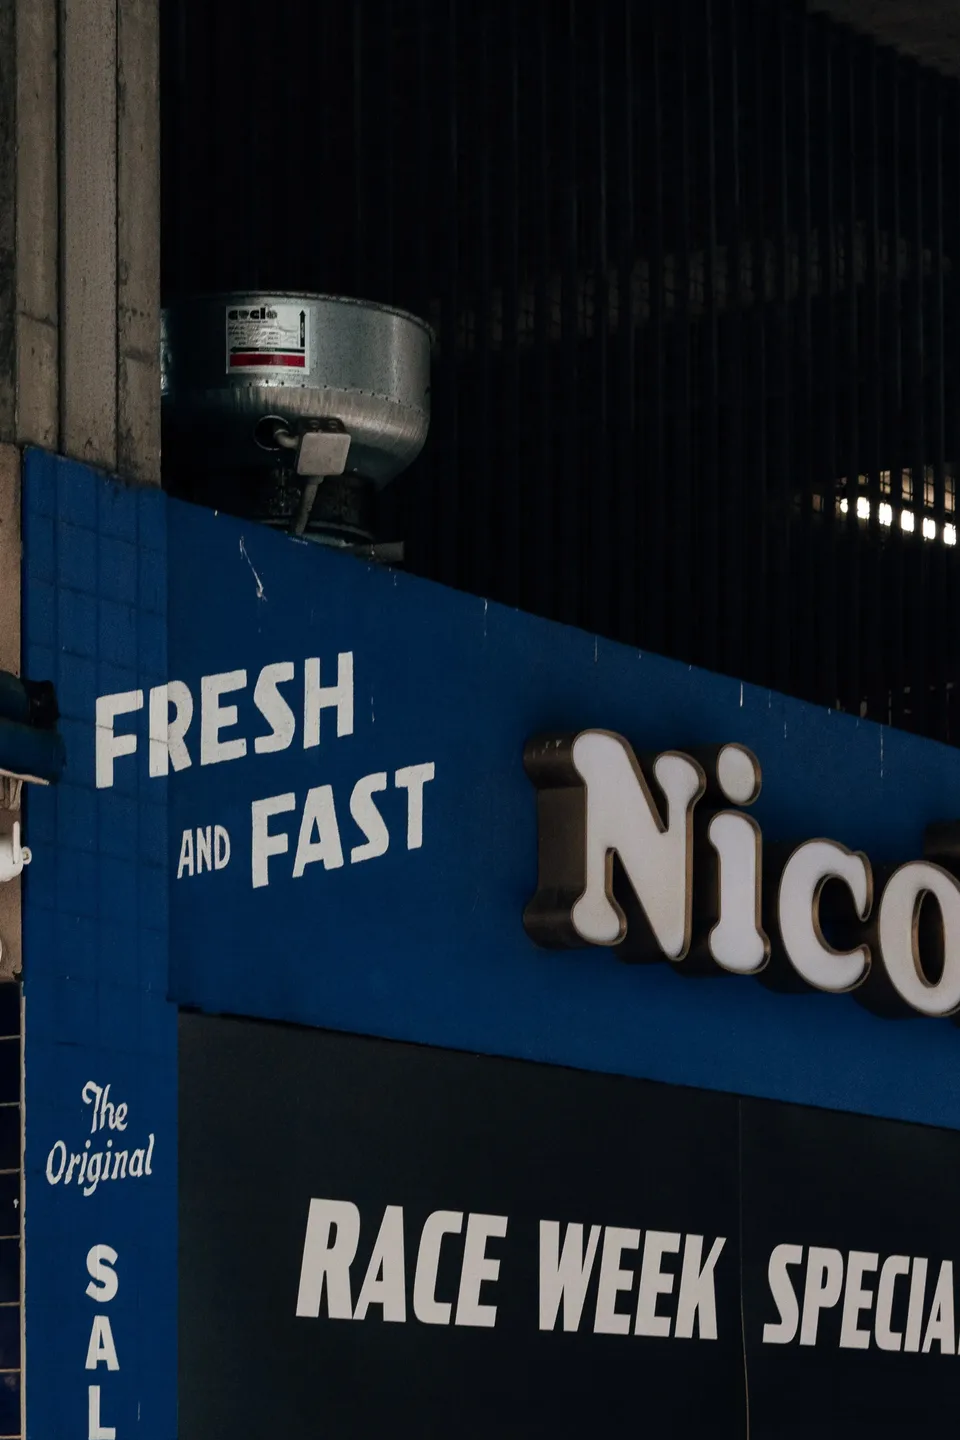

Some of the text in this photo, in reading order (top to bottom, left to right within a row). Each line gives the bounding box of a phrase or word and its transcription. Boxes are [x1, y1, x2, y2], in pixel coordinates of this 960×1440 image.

[96, 651, 354, 789] FRESH
[177, 761, 435, 889] AND FAST
[46, 1133, 155, 1197] Original
[82, 1080, 128, 1134] The
[295, 1198, 508, 1328] RACE
[539, 1219, 727, 1340] WEEK
